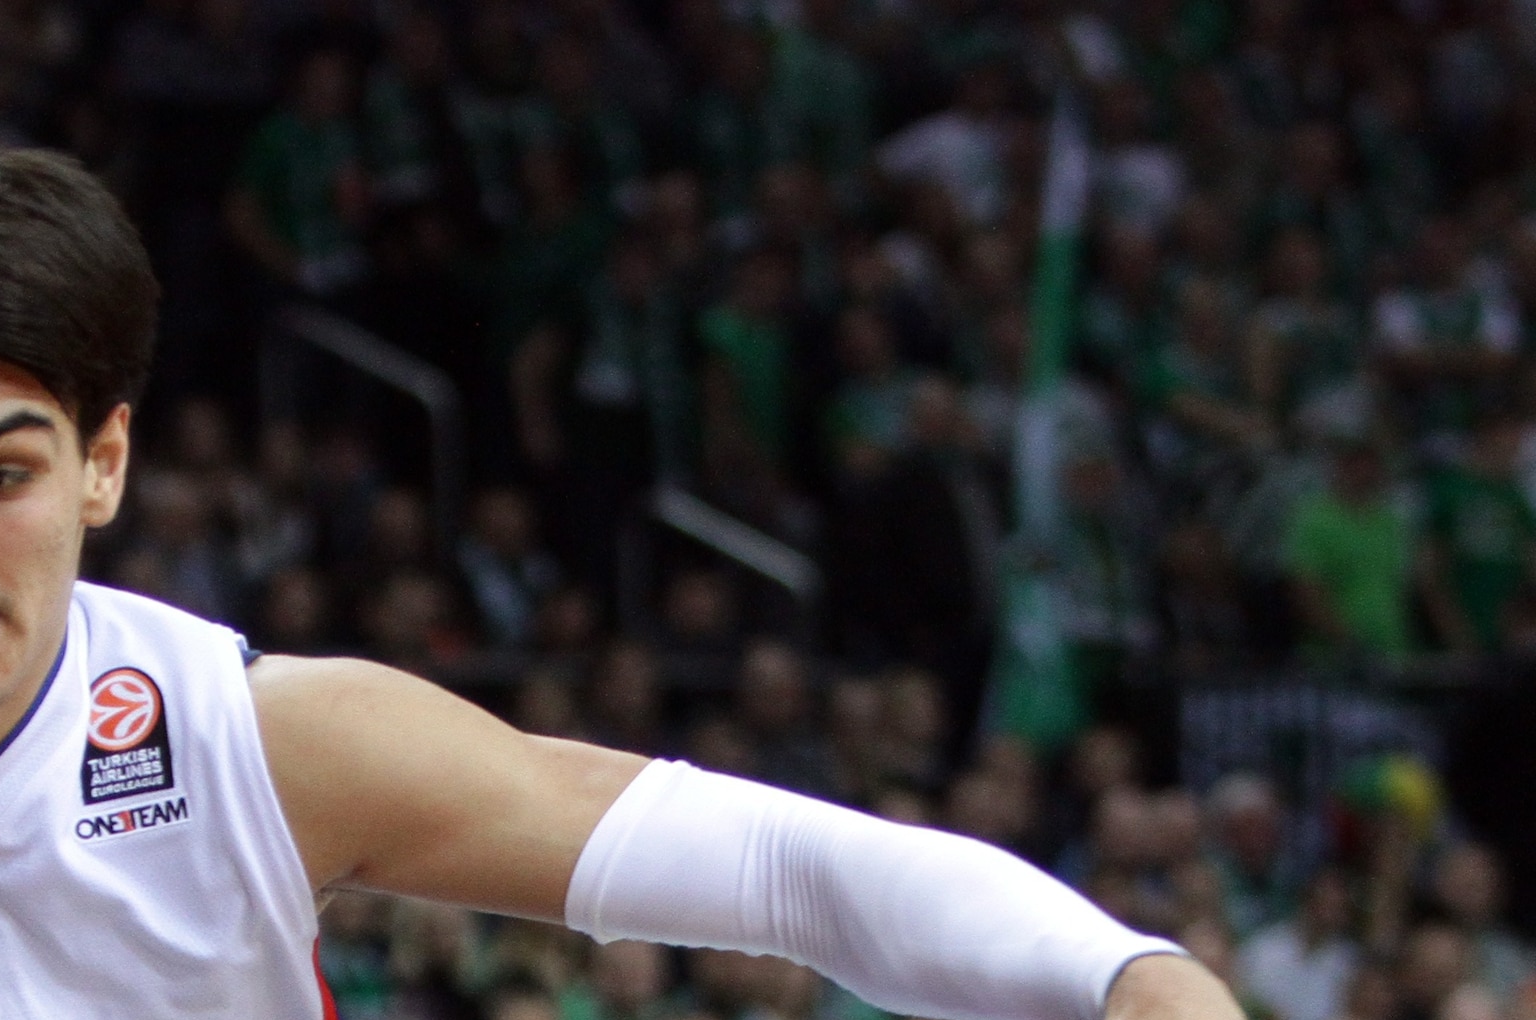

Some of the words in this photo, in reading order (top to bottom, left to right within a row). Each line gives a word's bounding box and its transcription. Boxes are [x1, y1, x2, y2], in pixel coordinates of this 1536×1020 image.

[87, 746, 161, 772] TURKISH
[90, 760, 163, 787] AIRLINES
[90, 774, 165, 798] EUROLEAGUE
